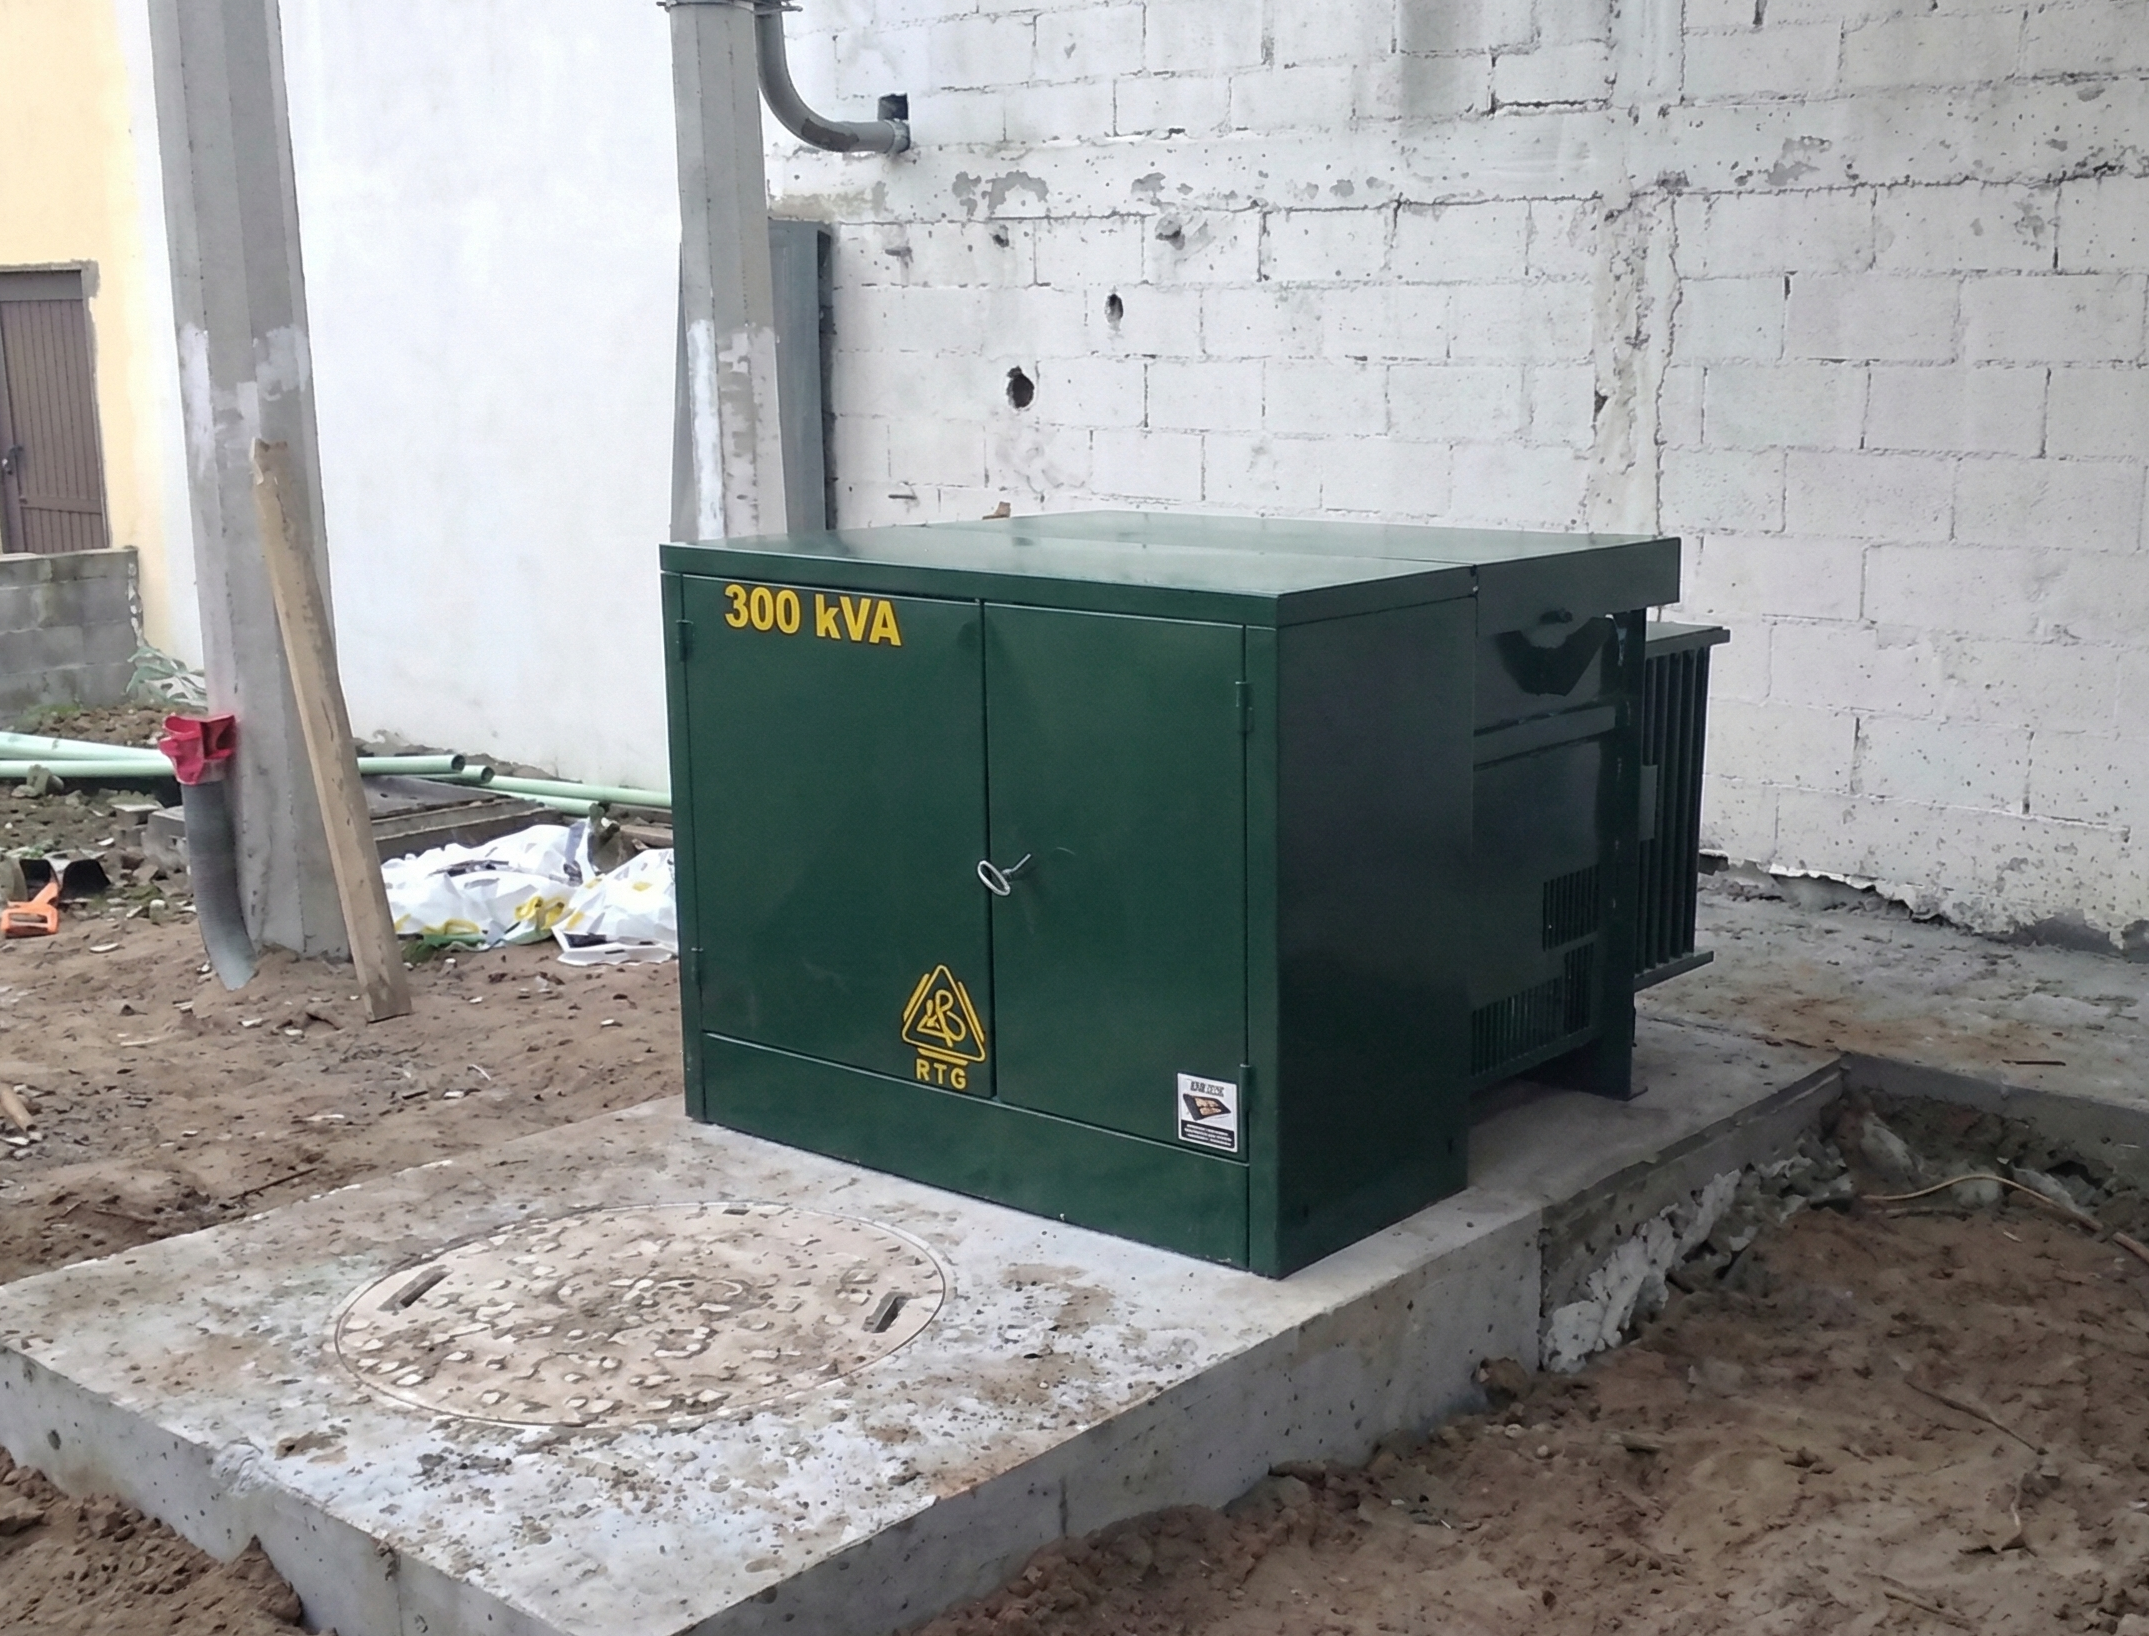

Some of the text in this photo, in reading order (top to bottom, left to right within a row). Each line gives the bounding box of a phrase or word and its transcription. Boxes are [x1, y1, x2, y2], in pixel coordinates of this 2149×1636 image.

[724, 584, 902, 647] 300 kVA
[915, 1058, 968, 1090] RTG
